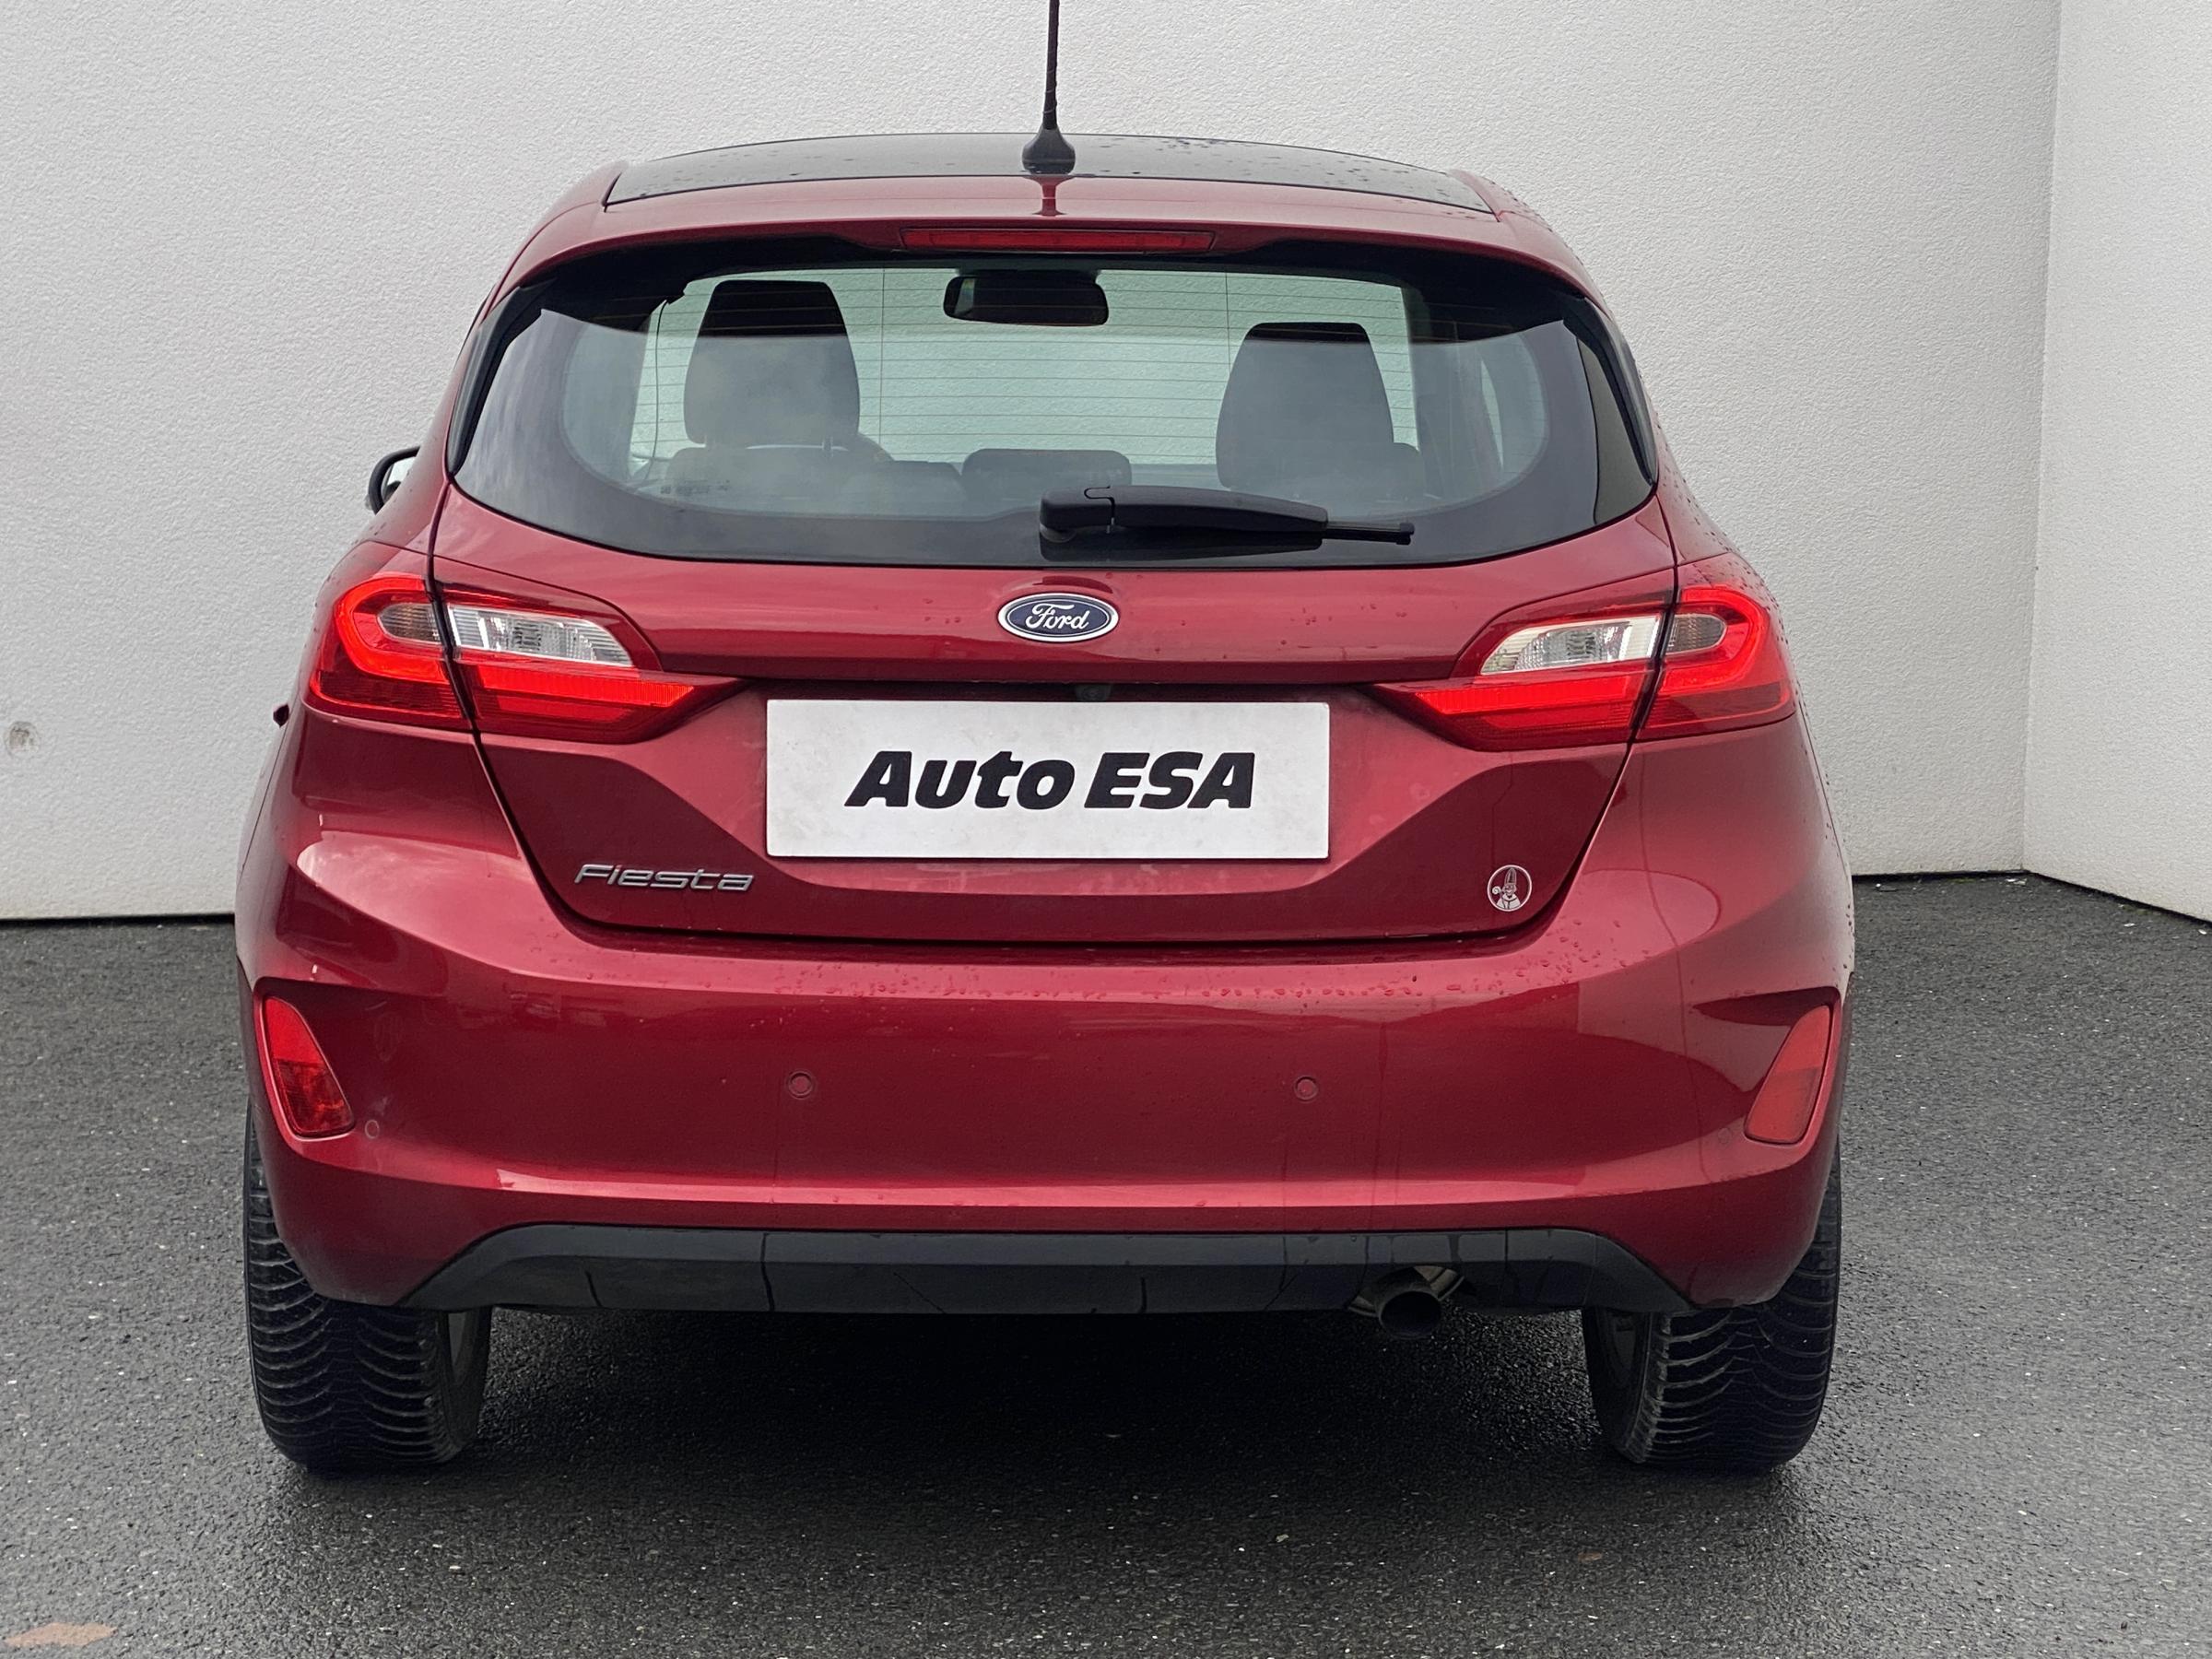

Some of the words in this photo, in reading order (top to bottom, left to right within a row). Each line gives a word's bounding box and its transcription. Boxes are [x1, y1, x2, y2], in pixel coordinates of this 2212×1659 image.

[1025, 603, 1090, 629] Ford
[843, 750, 1075, 809] Auto
[1084, 751, 1254, 809] ESA
[573, 863, 754, 891] Fiesta
